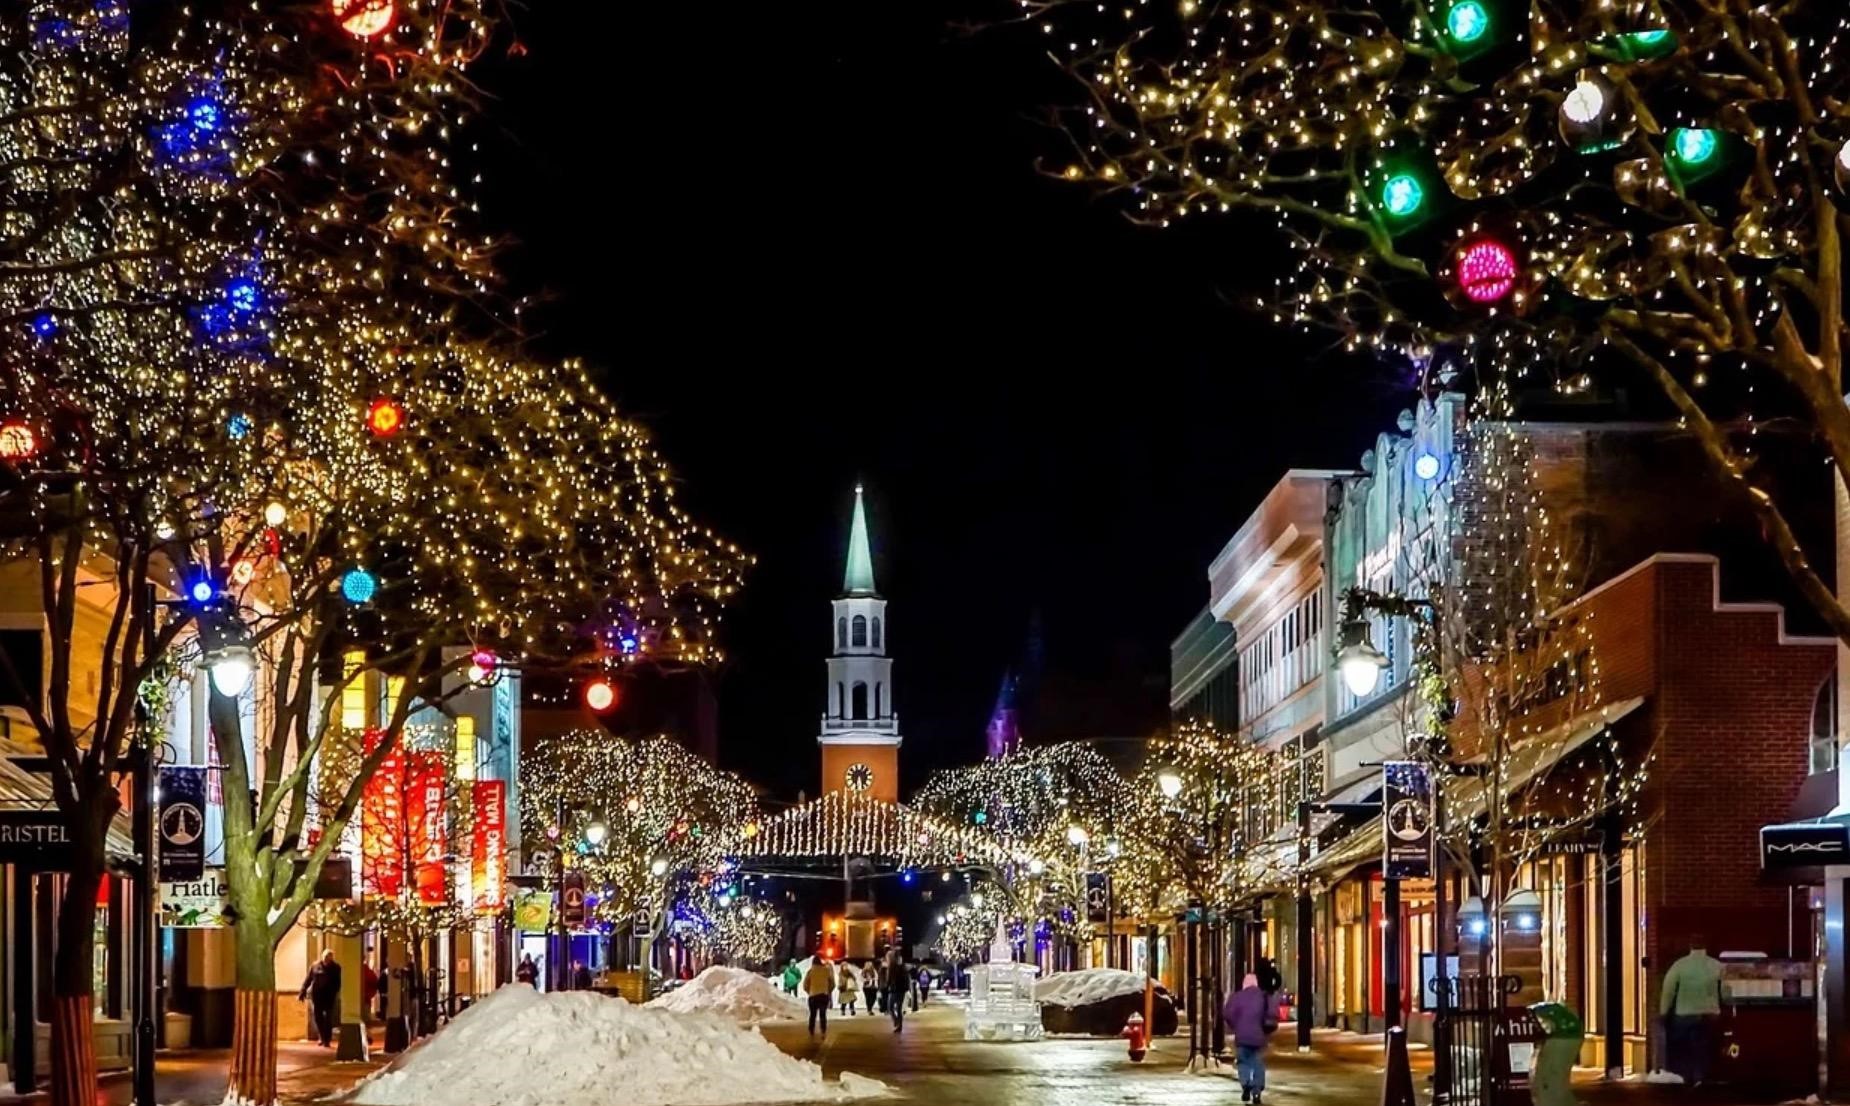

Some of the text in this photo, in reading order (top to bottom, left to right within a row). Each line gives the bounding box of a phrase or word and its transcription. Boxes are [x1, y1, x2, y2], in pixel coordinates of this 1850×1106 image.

[1, 824, 71, 843] RISTEL
[485, 785, 500, 906] SHOPPING MALL
[1767, 840, 1842, 854] MAC
